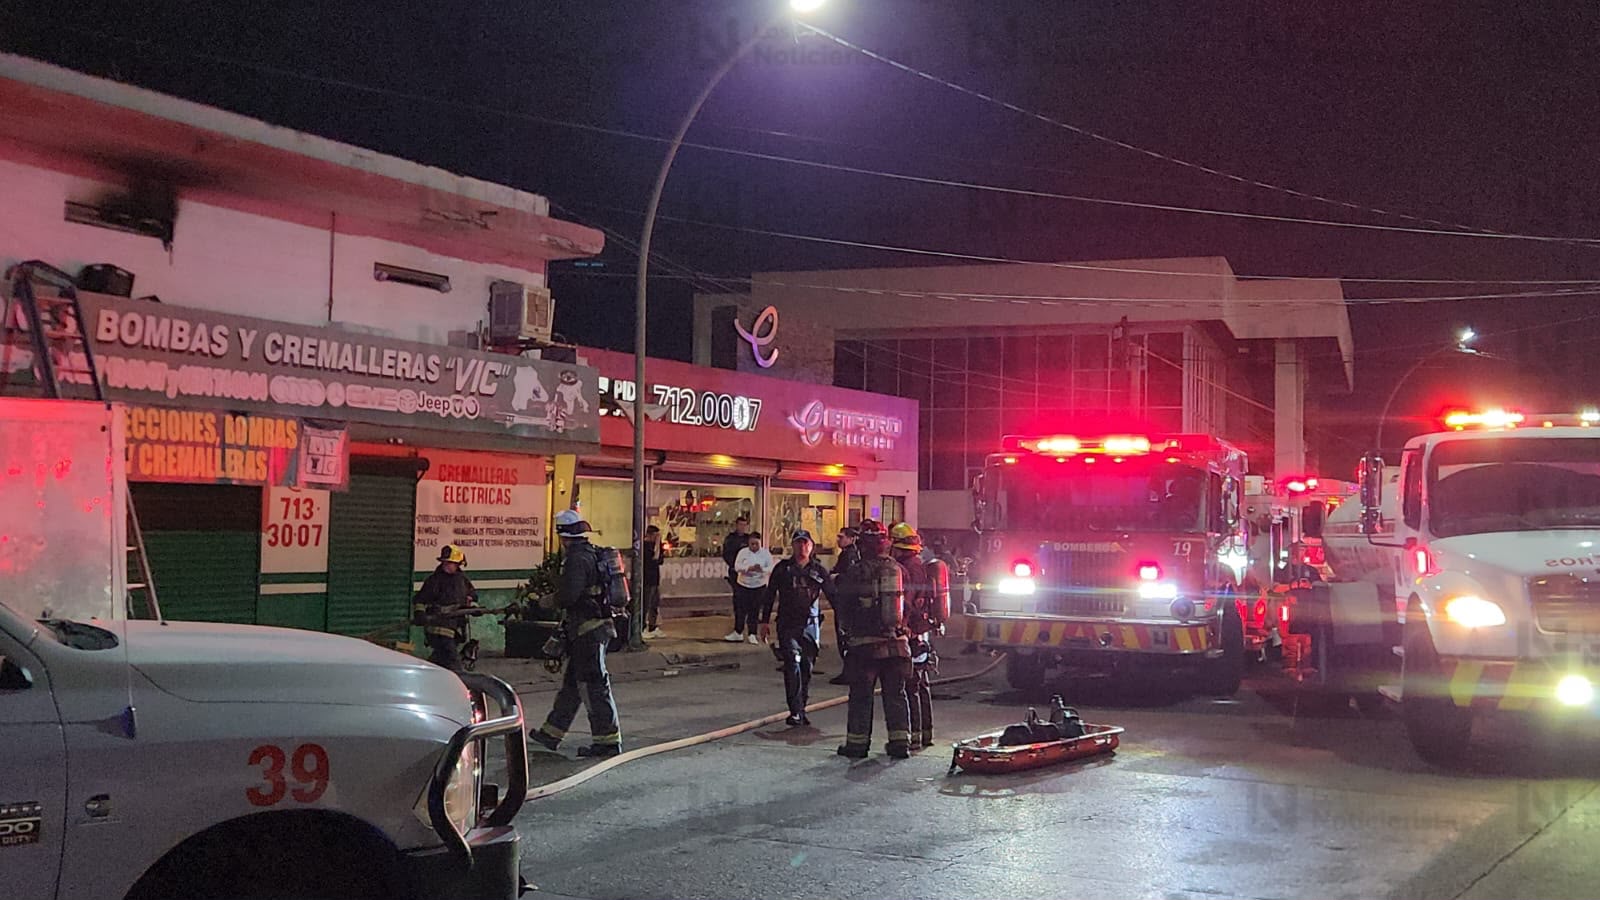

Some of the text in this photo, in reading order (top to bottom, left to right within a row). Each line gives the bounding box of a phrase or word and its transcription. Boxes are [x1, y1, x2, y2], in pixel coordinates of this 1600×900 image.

[97, 309, 230, 358] BOMBAS
[239, 328, 258, 360] Y
[264, 332, 441, 382] CREMALLERAS
[418, 392, 450, 414] Jeep
[613, 379, 637, 401] PID
[653, 384, 762, 432] 712.0007
[224, 412, 298, 449] BOMBAS
[138, 442, 269, 482] CREMALLERAS
[438, 463, 519, 486] CREMALLERAS
[443, 485, 512, 506] ELECTRICAS
[1054, 541, 1119, 553] BOMBEROS
[1173, 541, 1191, 556] 19
[245, 743, 330, 807] 39
